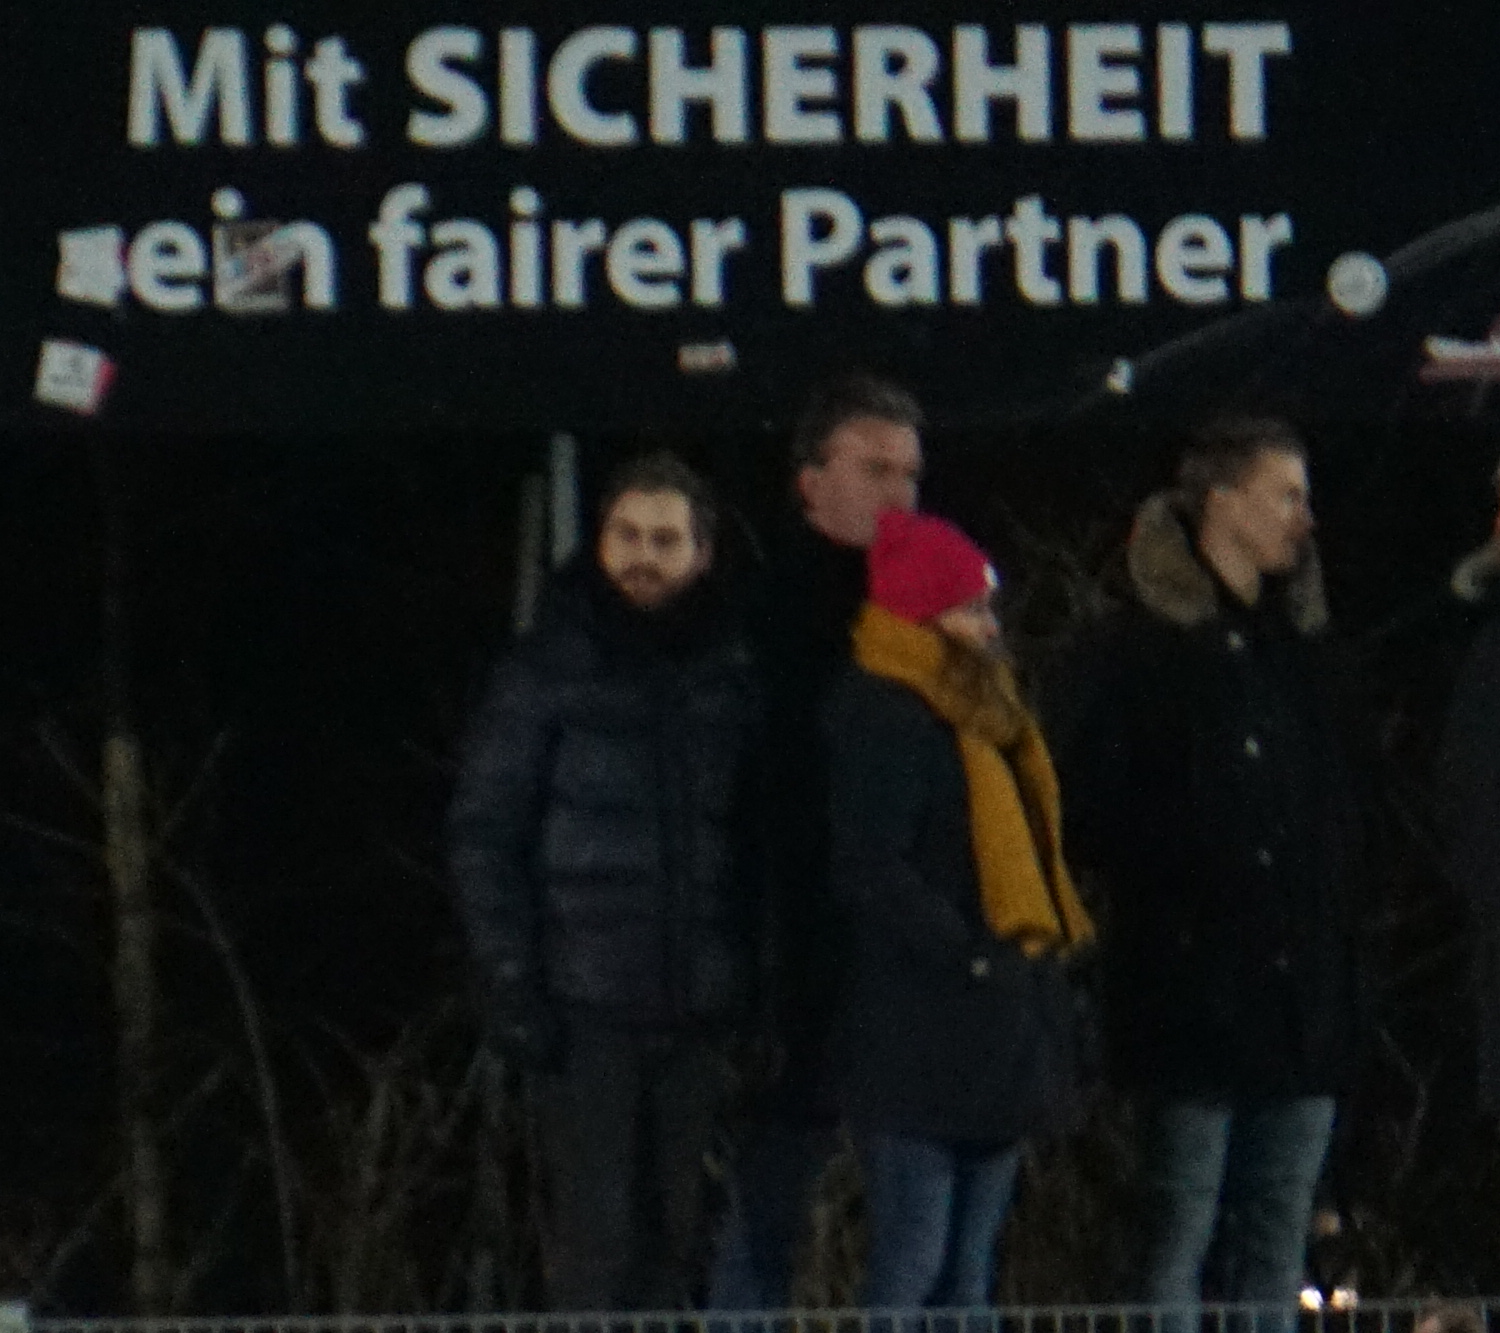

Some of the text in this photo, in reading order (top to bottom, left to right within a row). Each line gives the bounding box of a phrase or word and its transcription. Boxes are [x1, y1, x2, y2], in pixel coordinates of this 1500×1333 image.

[126, 22, 1292, 147] Mit SICHERHEIT
[124, 183, 1293, 310] ein fairer Partner
